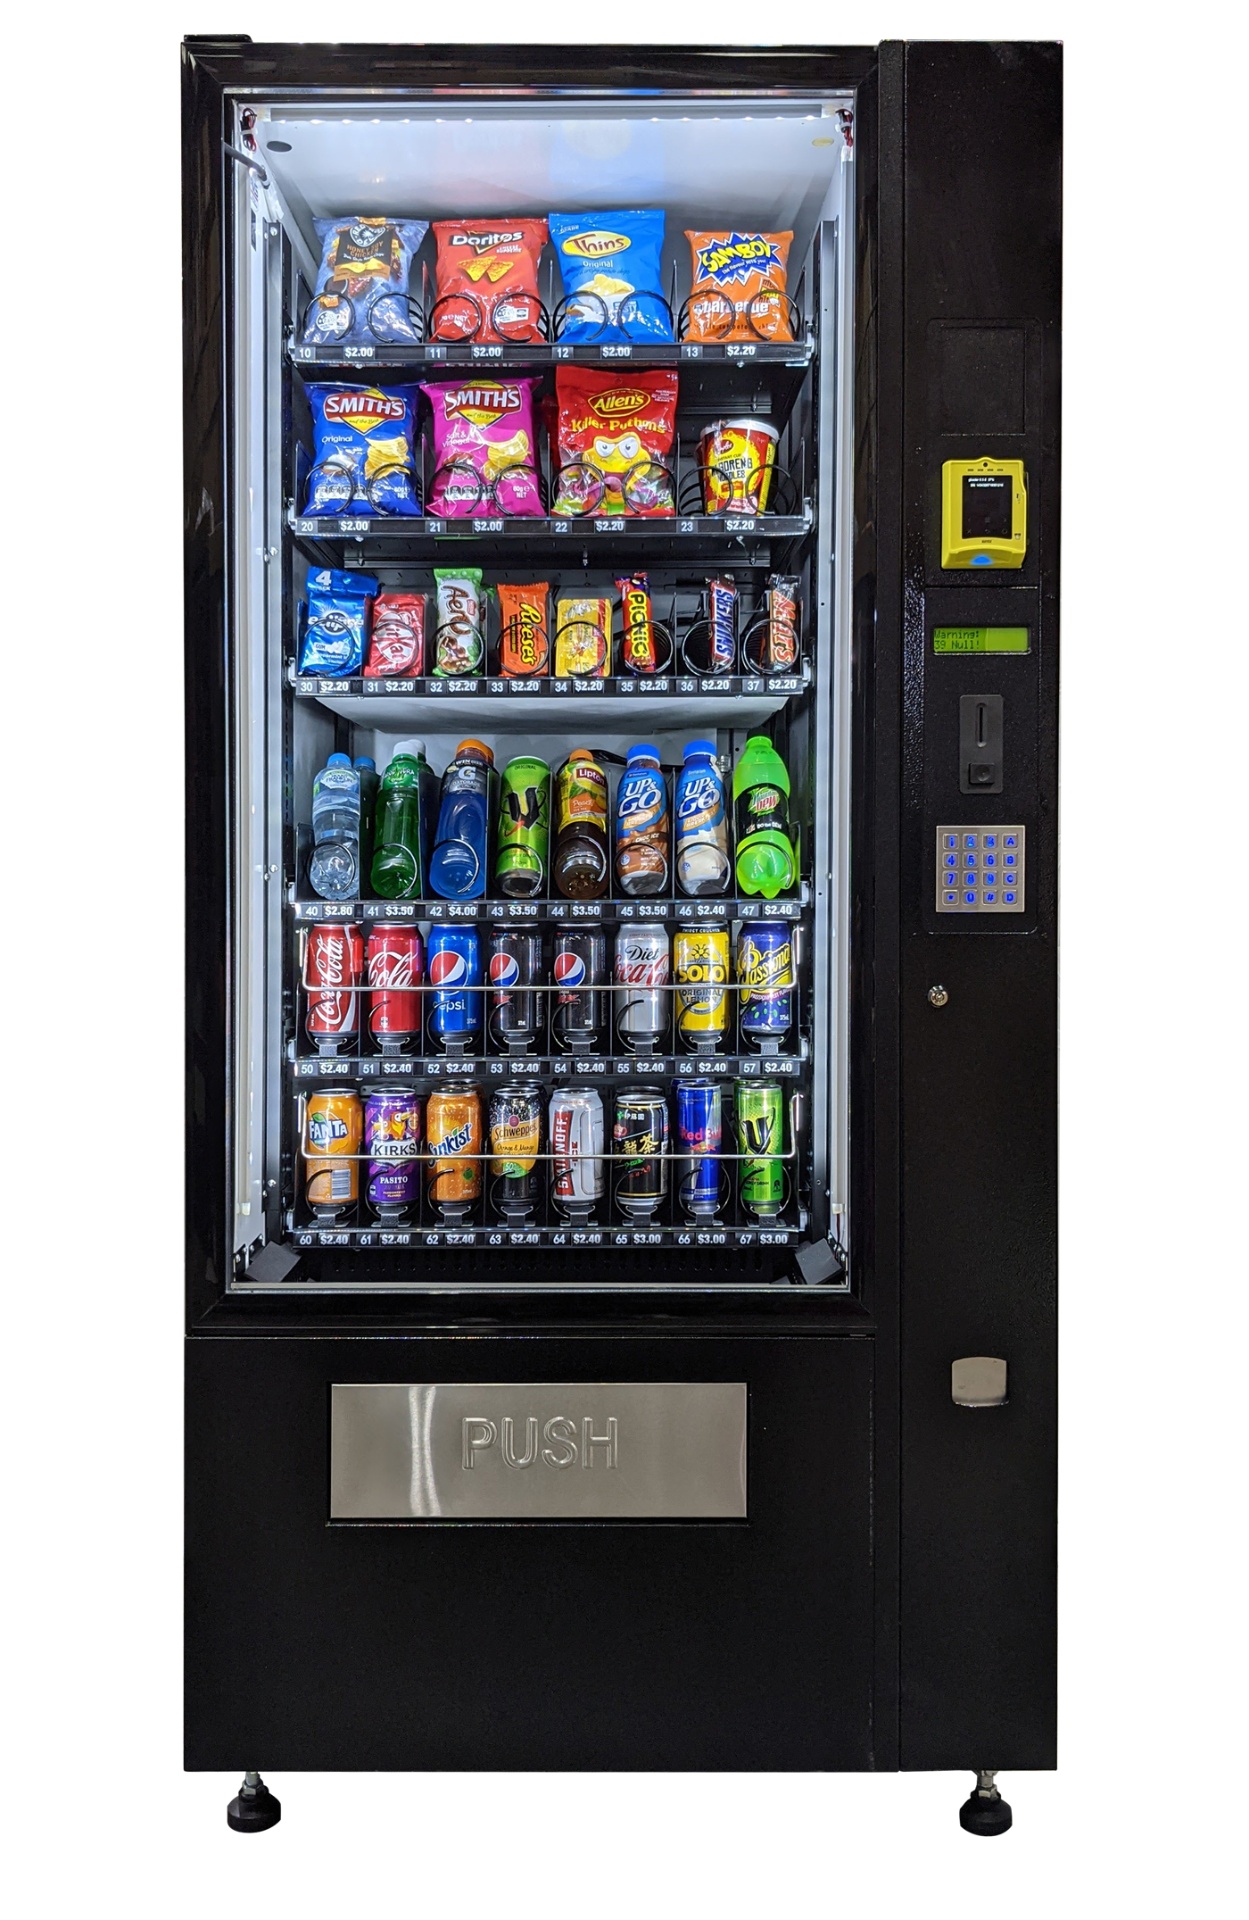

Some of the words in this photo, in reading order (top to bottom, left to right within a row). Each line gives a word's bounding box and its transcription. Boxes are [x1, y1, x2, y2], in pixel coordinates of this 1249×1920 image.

[452, 232, 523, 245] Doritos
[566, 233, 625, 254] Thins
[702, 240, 771, 273] SAMBOY
[583, 260, 614, 269] Original
[299, 349, 311, 359] 10
[345, 347, 374, 359] $2.00
[430, 349, 441, 358] 11
[473, 348, 501, 359] $2.00
[556, 348, 569, 359] 12
[602, 346, 630, 358] $2.00
[686, 348, 699, 358] 13
[727, 345, 755, 357] $2.20
[445, 389, 520, 412] SMITH'S
[594, 394, 645, 412] Allen's
[326, 396, 403, 417] SMITH'S
[571, 416, 606, 433] Killer
[321, 435, 353, 444] Original
[516, 491, 527, 499] NET
[301, 522, 314, 532] 20
[340, 520, 369, 531] $2.00
[430, 522, 441, 532] 21
[474, 520, 503, 532] $2.00
[555, 523, 568, 533] 22
[596, 521, 624, 531] $2.20
[681, 522, 694, 532] 23
[726, 520, 754, 531] $2.20
[315, 570, 332, 586] 4
[440, 585, 472, 636] Aero
[630, 593, 649, 656] PICNIC
[520, 603, 542, 666] Reese's
[934, 629, 979, 639] Warning:
[934, 640, 947, 650] 39
[951, 640, 979, 650] Null!
[300, 682, 313, 692] 30
[320, 681, 349, 692] $2.20
[367, 682, 379, 692] 31
[385, 681, 414, 692] $2.20
[430, 682, 443, 692] 32
[448, 681, 476, 692] $2.20
[491, 682, 503, 692] 33
[510, 681, 539, 692] $2.20
[554, 682, 568, 692] 34
[574, 681, 603, 692] $2.20
[621, 682, 634, 692] 35
[640, 681, 668, 692] $2.20
[681, 682, 694, 692] 36
[701, 681, 730, 692] $2.20
[747, 681, 760, 691] 37
[768, 679, 798, 690] $2.20
[458, 765, 477, 780] G
[579, 769, 605, 786] Lipton
[618, 789, 662, 818] GO
[678, 788, 720, 818] GO
[635, 834, 650, 843] CHOC
[306, 906, 318, 916] 40
[324, 905, 353, 916] $2.80
[367, 906, 380, 916] 41
[385, 905, 414, 916] $3.50
[430, 906, 443, 916] 42
[448, 905, 477, 916] $4.00
[491, 906, 504, 916] 43
[509, 905, 537, 916] $3.50
[551, 906, 565, 916] 44
[572, 905, 600, 916] $3.50
[620, 906, 634, 916] 45
[639, 905, 667, 916] $3.50
[679, 906, 692, 916] 46
[697, 905, 725, 916] $2.40
[742, 906, 755, 916] 47
[764, 905, 792, 916] $2.40
[625, 944, 660, 961] Diet
[679, 965, 725, 983] SOLO
[681, 988, 721, 997] ORIGINAL
[301, 1064, 314, 1074] 50
[320, 1063, 348, 1074] $2.40
[362, 1064, 374, 1074] 51
[384, 1063, 412, 1074] $2.40
[427, 1064, 440, 1074] 52
[446, 1063, 474, 1074] $2.40
[490, 1064, 503, 1074] 53
[511, 1063, 539, 1074] $2.40
[554, 1064, 567, 1074] 54
[576, 1063, 605, 1073] $2.40
[617, 1064, 630, 1074] 55
[636, 1063, 664, 1073] $2.40
[679, 1064, 692, 1074] 56
[698, 1063, 727, 1073] $2.40
[743, 1064, 756, 1074] 57
[764, 1063, 792, 1073] $2.40
[309, 1120, 348, 1139] FANTA
[494, 1123, 538, 1141] Schweppes
[681, 1127, 703, 1141] Red
[374, 1142, 416, 1156] KIRKS
[428, 1123, 472, 1168] Sunkist
[380, 1175, 408, 1184] PASITO
[300, 1235, 312, 1245] 60
[320, 1234, 348, 1244] $2.40
[360, 1235, 372, 1245] 61
[381, 1234, 410, 1244] $2.40
[426, 1235, 439, 1245] 62
[446, 1234, 474, 1244] $2.40
[489, 1235, 502, 1245] 63
[510, 1234, 539, 1244] $2.40
[553, 1234, 566, 1244] 64
[573, 1234, 601, 1244] $2.40
[615, 1234, 628, 1244] 65
[634, 1234, 662, 1244] $3.00
[678, 1234, 691, 1244] 66
[698, 1234, 726, 1244] $3.00
[739, 1234, 752, 1244] 67
[760, 1234, 788, 1244] $3.00
[462, 1416, 618, 1470] PUSH
